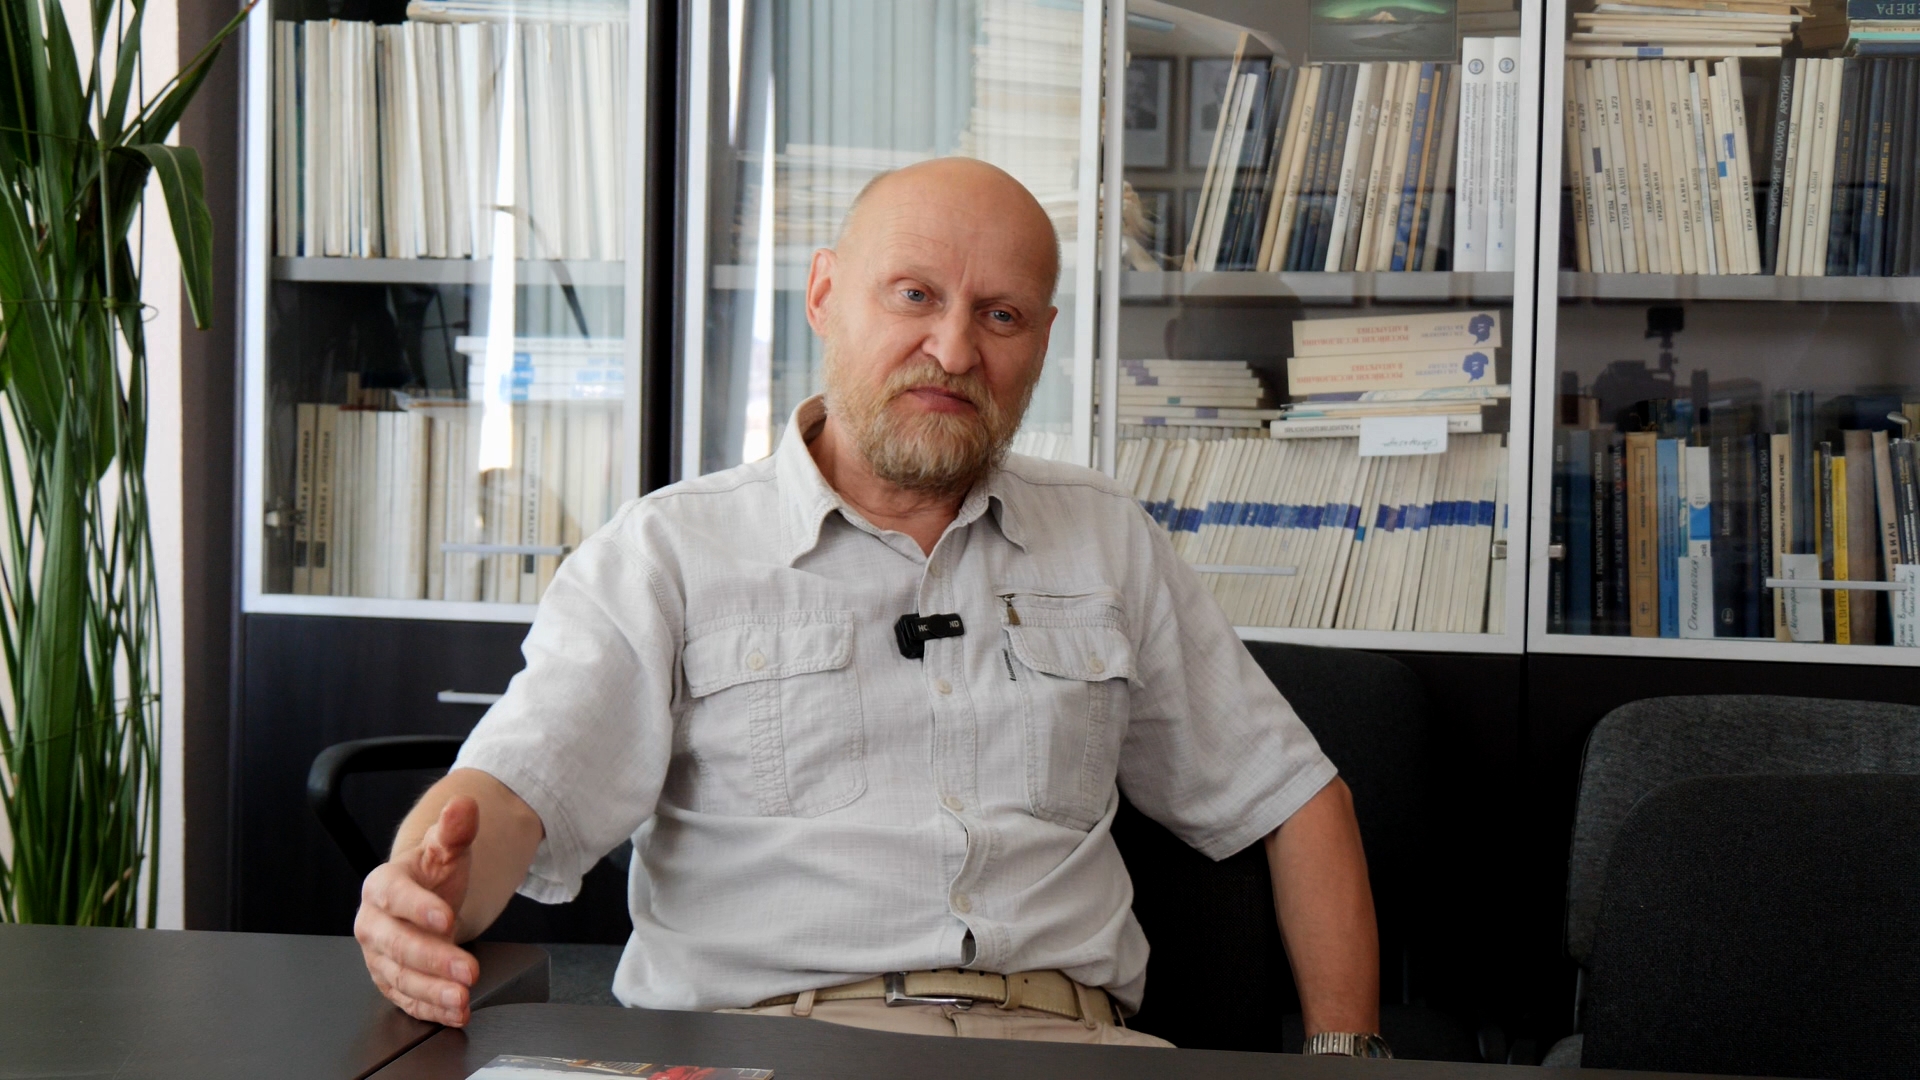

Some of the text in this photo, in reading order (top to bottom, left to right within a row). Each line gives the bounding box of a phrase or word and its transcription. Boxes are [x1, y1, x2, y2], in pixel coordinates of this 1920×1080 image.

[1875, 3, 1920, 15] ВЕРА
[1769, 75, 1790, 225] МОНИТОРИНГ КЛИМАТА АРКТИКИ
[1618, 167, 1626, 195] ААНИИ
[1679, 178, 1687, 203] ААНИИ
[1691, 168, 1699, 191] ААНИИ
[1810, 171, 1818, 194] ААНИИ
[1783, 187, 1791, 207] ТРУДЫ
[1877, 190, 1886, 216] ТРУДЫ
[1607, 200, 1615, 223] ТРУДЫ
[1620, 203, 1630, 230] ТРУДЫ
[1682, 210, 1690, 232] ТРУДЫ
[1745, 208, 1753, 231] ТРУДЫ
[1807, 204, 1815, 227] ТРУДЫ
[1302, 334, 1409, 346] РОССИЙСКИЕ ИССЛЕДОВАНИЯ
[1356, 325, 1402, 334] АНТАРКТИКЕ
[1296, 372, 1403, 383] РОССИЙСКИЕ ИССЛЕДОВАНИЯ
[1351, 363, 1396, 372] АНТАРКТИКЕ
[1594, 452, 1602, 493] ПРОГНОЗЫ
[1613, 446, 1622, 483] ОКЕАНА
[1760, 449, 1768, 486] АРКТИКИ
[1614, 487, 1623, 534] МИРОВОГО
[1760, 493, 1769, 532] КЛИМАТА
[1595, 499, 1603, 574] ГИДРОЛОГИЧЕСКИЕ
[1614, 539, 1623, 564] МОРЯ
[1687, 559, 1698, 631] Океанология
[1838, 572, 1847, 619] ВИТЕС
